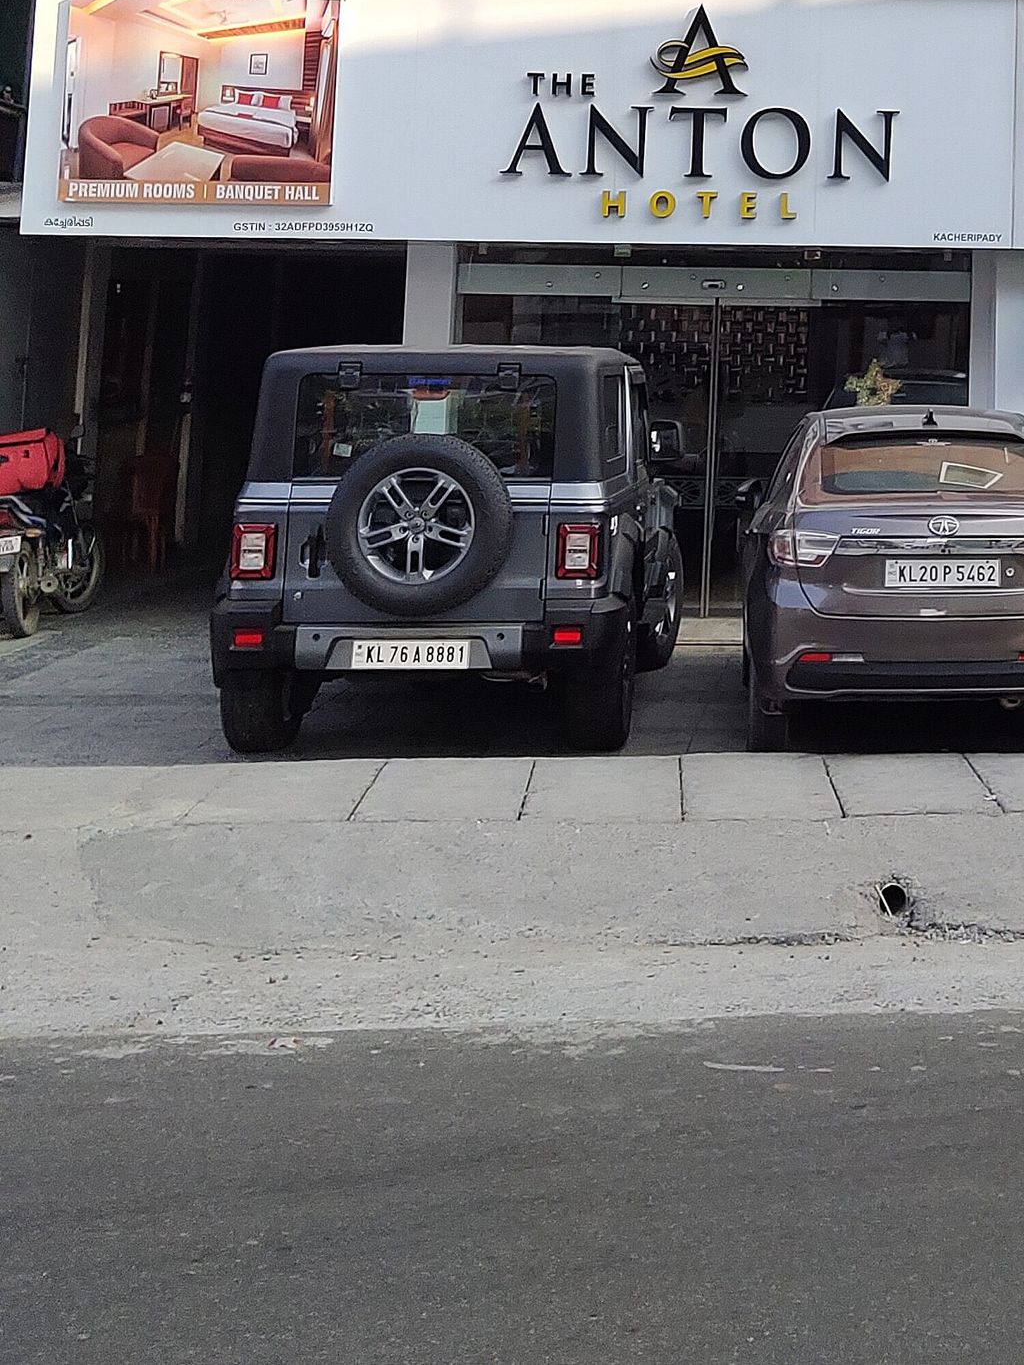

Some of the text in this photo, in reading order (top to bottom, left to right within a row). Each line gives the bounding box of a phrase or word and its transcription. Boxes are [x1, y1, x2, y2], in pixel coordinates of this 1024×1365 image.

[526, 71, 596, 96] THE
[499, 102, 900, 182] ANTON
[68, 183, 195, 198] PREMIUM ROOMS
[215, 185, 320, 201] BANQUET HALL
[601, 190, 797, 219] HOTEL
[233, 222, 266, 232] GSTIN
[933, 232, 1002, 242] KACHERIPADY
[956, 565, 996, 583] 5462
[366, 645, 464, 664] KL 76 A 8881
